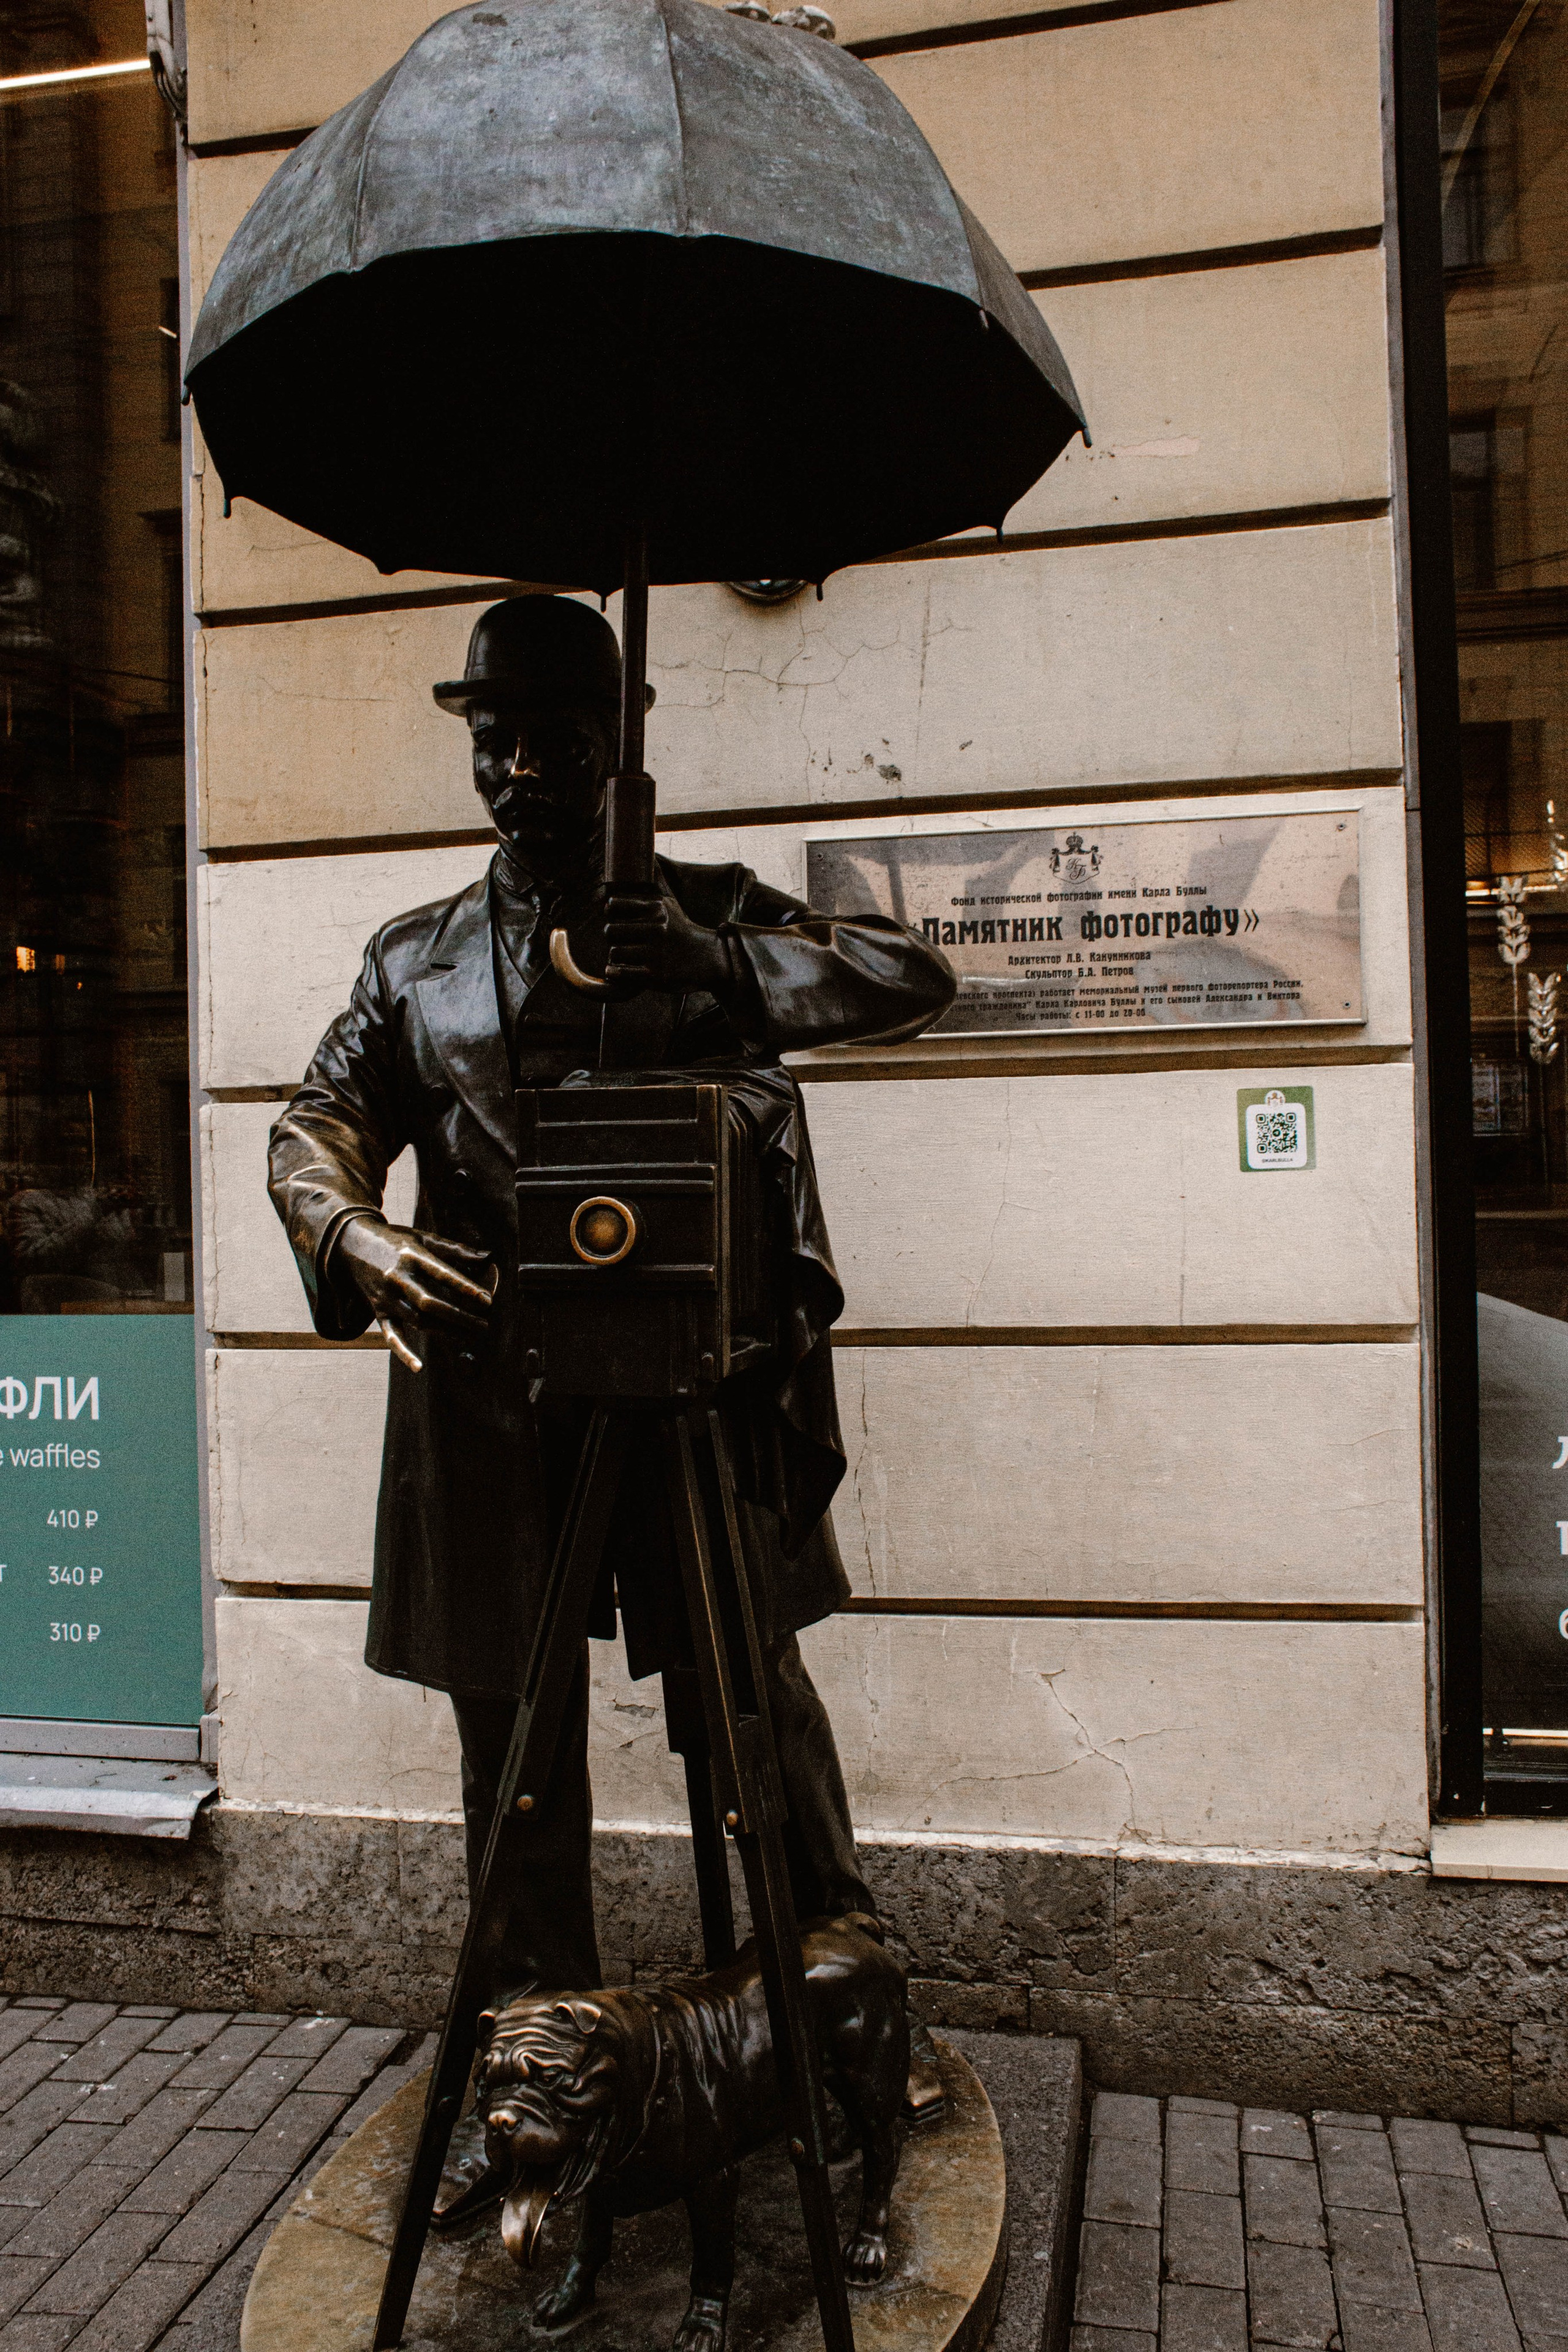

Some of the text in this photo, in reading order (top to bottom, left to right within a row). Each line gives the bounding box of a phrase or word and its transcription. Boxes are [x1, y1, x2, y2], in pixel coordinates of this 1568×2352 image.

[981, 892, 1041, 905] исторической
[1047, 891, 1102, 903] фотографии
[1108, 889, 1137, 899] имени
[1142, 887, 1170, 897] Карла
[1176, 886, 1207, 896] Буллы
[1080, 905, 1260, 942] фотографу»
[1008, 951, 1151, 966] Архитектор Л.В. Канунникова
[1025, 965, 1134, 980] Скульптор Б.А. Петров
[1040, 989, 1075, 998] работает
[1079, 986, 1139, 997] мемориальный
[1144, 983, 1168, 993] музей
[1172, 983, 1204, 993] первого
[1207, 981, 1268, 992] фоторепортера
[1036, 1000, 1059, 1009] Карла
[1063, 998, 1106, 1009] Карловича
[1110, 997, 1137, 1008] Буллы
[1140, 997, 1145, 1006] и
[1150, 997, 1163, 1006] его
[1167, 994, 1200, 1005] сыновей
[1205, 993, 1253, 1003] Александра
[1257, 993, 1262, 1001] и
[1267, 991, 1300, 1001] Виктора
[1016, 1012, 1036, 1021] Часы
[1041, 1011, 1071, 1021] работы:
[1084, 1009, 1105, 1019] 11-00
[1109, 1009, 1119, 1018] до
[0, 1376, 99, 1420] ФЛИ
[9, 1443, 100, 1468] waffles
[47, 1509, 80, 1528] 410
[48, 1566, 84, 1586] 340
[50, 1623, 81, 1642] 310
